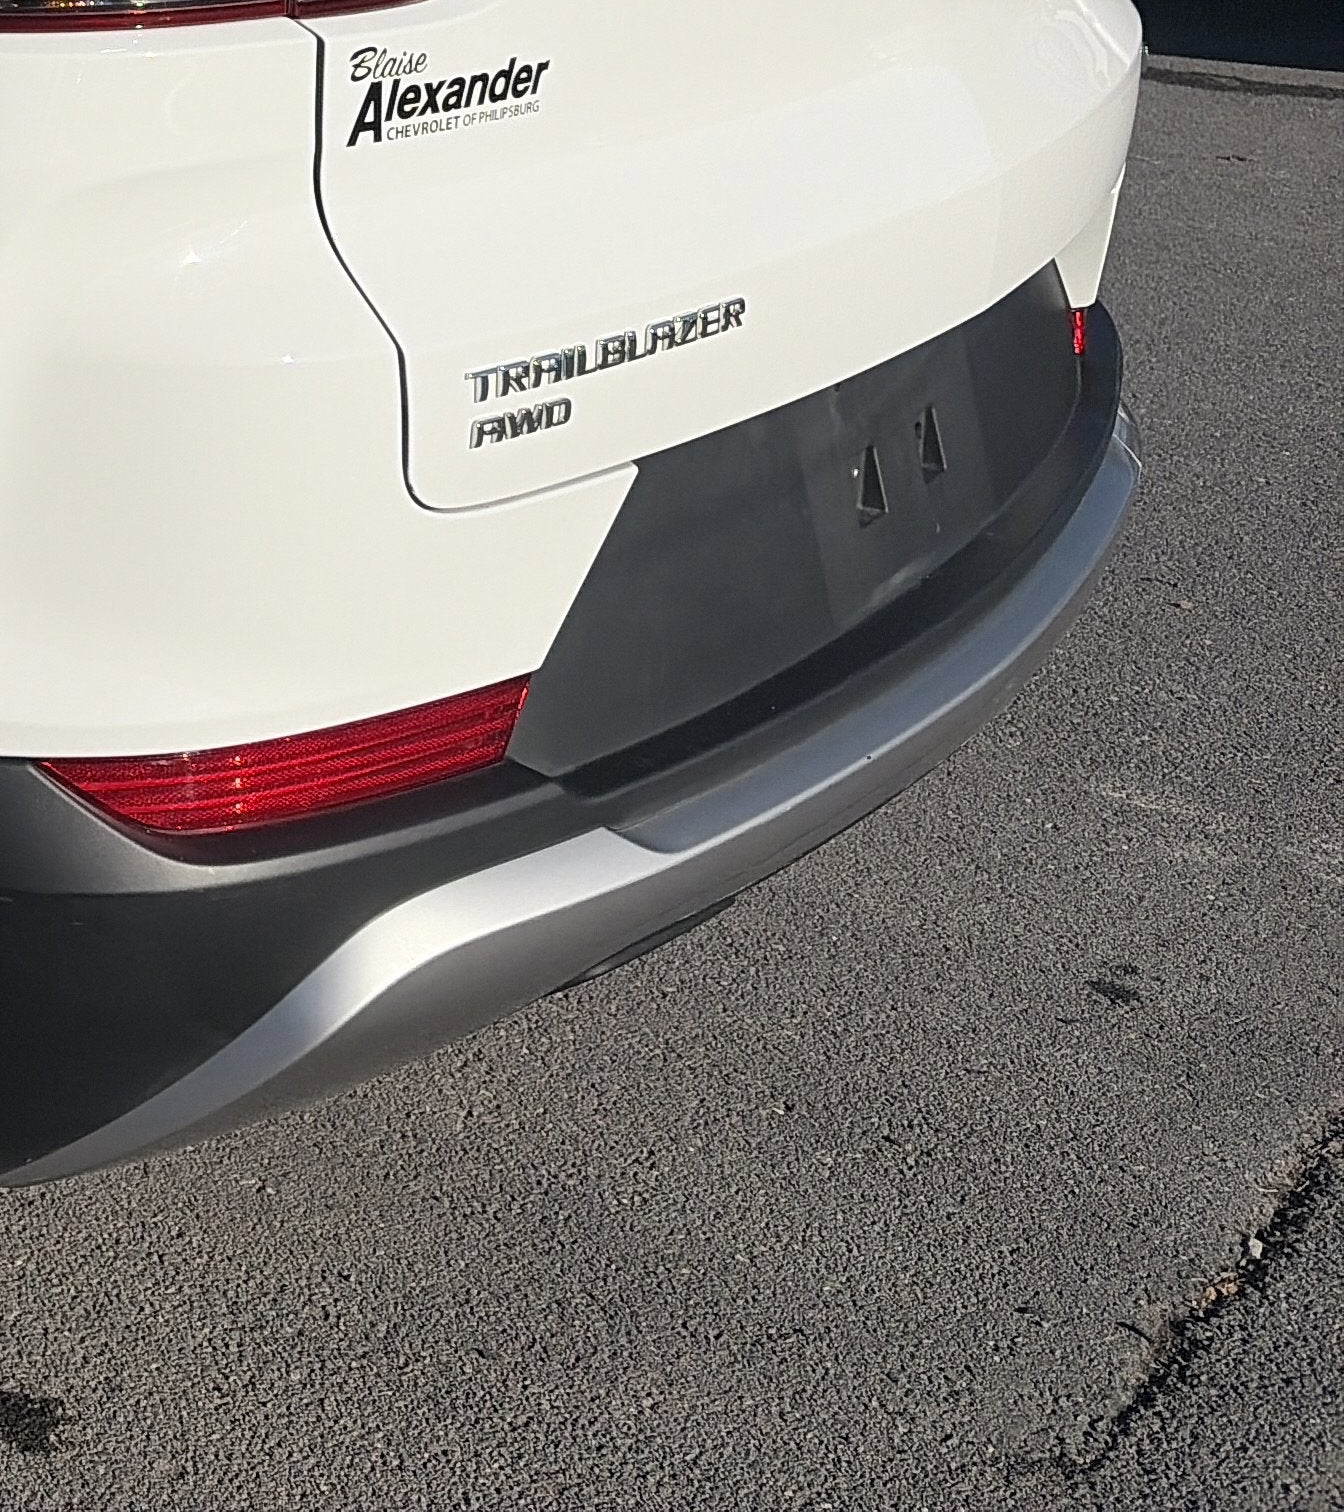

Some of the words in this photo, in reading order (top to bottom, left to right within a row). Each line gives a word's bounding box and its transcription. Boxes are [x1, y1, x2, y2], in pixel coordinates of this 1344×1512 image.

[349, 46, 428, 82] Blaise
[346, 57, 550, 148] Alexander
[386, 115, 459, 141] CHEVROLET
[462, 112, 478, 128] OF
[479, 99, 540, 123] PHILIPSBURG
[464, 296, 746, 404] TRAILBLAZER
[469, 397, 572, 450] AWD
